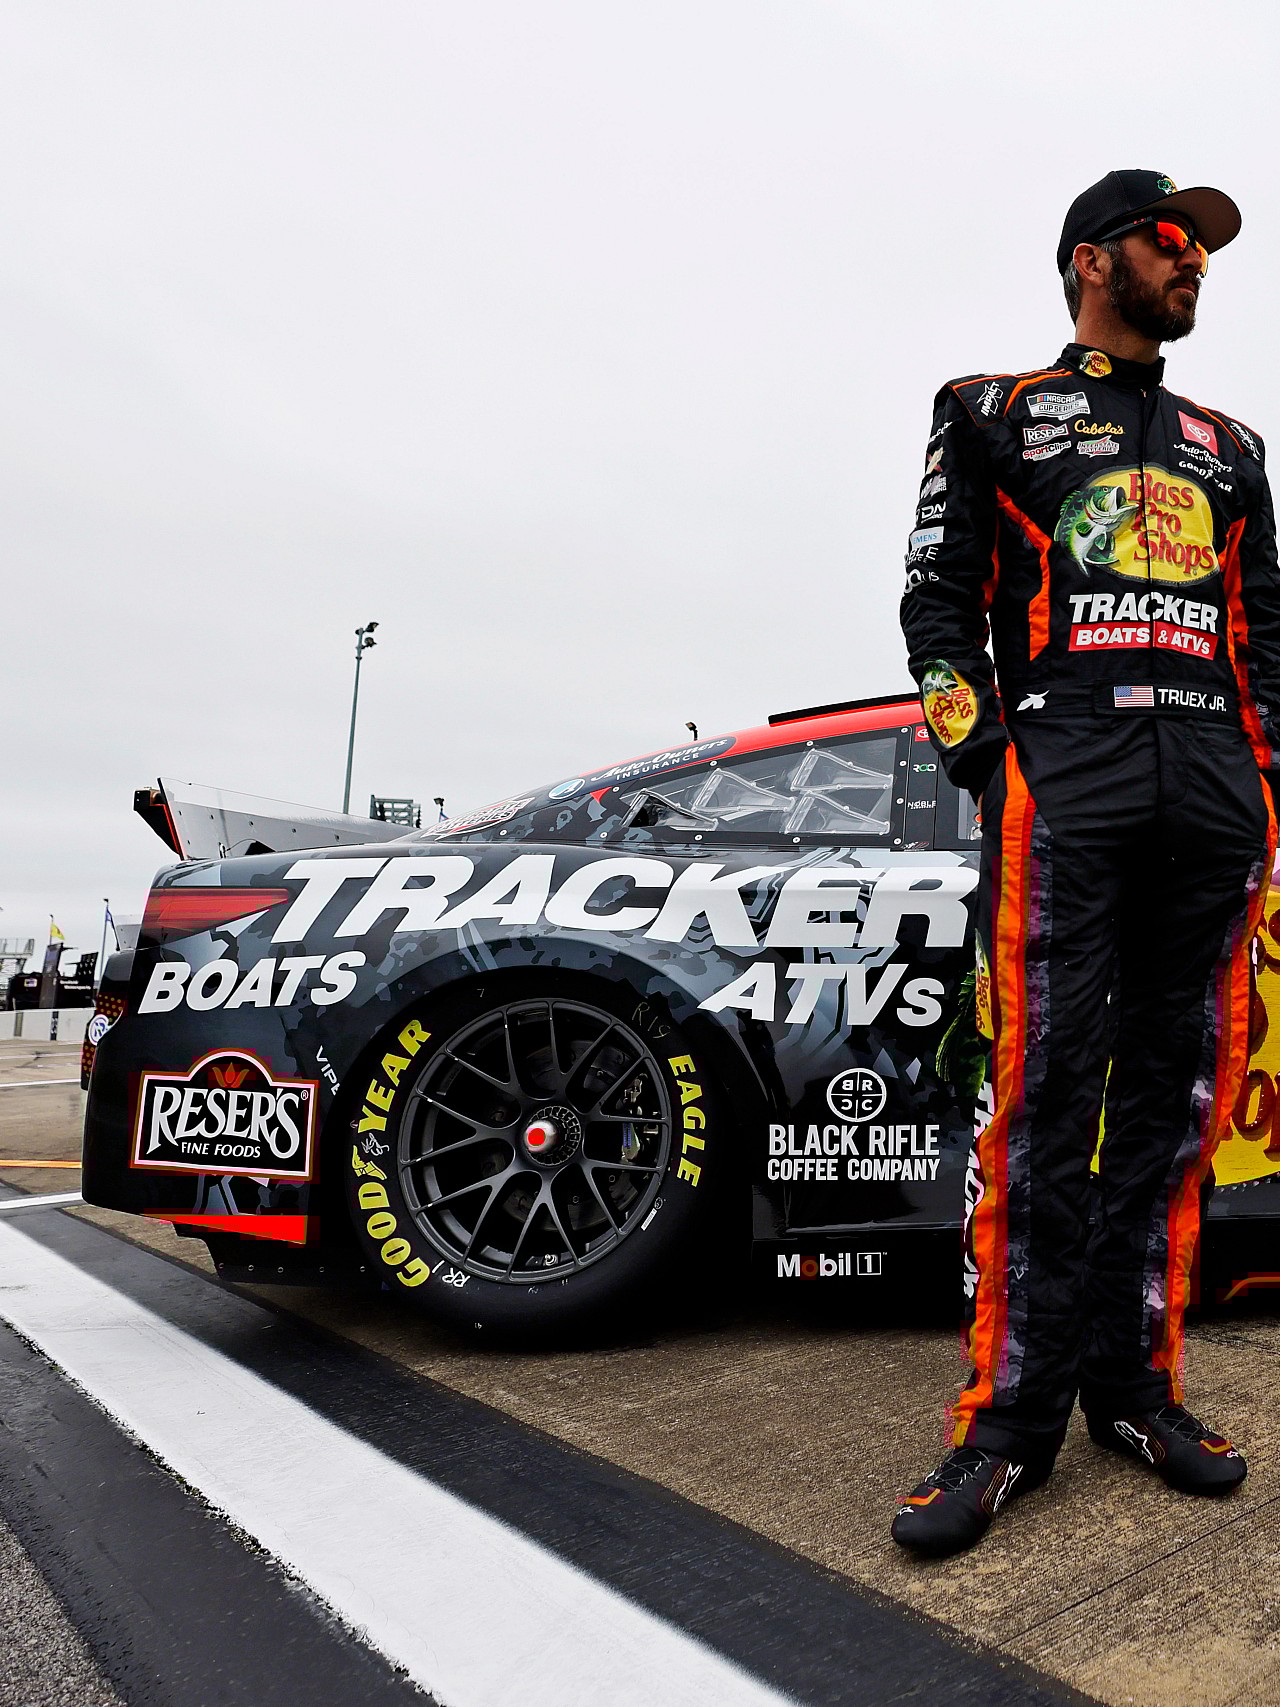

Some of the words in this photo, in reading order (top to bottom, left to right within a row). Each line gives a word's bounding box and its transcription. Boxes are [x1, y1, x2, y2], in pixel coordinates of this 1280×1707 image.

[980, 381, 1000, 416] IMPACT
[1038, 404, 1054, 412] CUP
[1046, 394, 1077, 404] NASCAR
[1074, 419, 1125, 435] Cabela's
[1173, 443, 1233, 472] Auto-Owners
[1128, 472, 1194, 508] Bass
[1178, 460, 1233, 492] GOODAR
[1131, 502, 1181, 534] Pro
[1134, 529, 1214, 574] Shops
[1069, 592, 1219, 634] TRACKER
[1076, 627, 1151, 646] BOATS
[1158, 630, 1168, 643] &
[1174, 633, 1210, 655] ATVs
[937, 694, 956, 719] Pro
[951, 687, 973, 719] Bass
[1158, 688, 1207, 709] TRUEX
[1209, 696, 1227, 712] JR.
[929, 701, 952, 744] Shops
[591, 739, 728, 782] Auto-Owners
[616, 752, 700, 780] INSURANCE
[270, 854, 980, 947] TRACKER
[137, 951, 366, 1014] BOATS
[697, 961, 945, 1027] ATVs
[145, 1085, 300, 1159] RESER'S
[667, 1054, 706, 1187] EAGLE
[181, 1142, 209, 1156] FINE
[214, 1143, 261, 1159] FOODS
[769, 1124, 859, 1156] BLACK
[868, 1124, 940, 1156] RIFLE
[767, 1158, 839, 1181] COFFEE
[847, 1158, 940, 1181] COMPANY
[777, 1253, 851, 1277] Mobil
